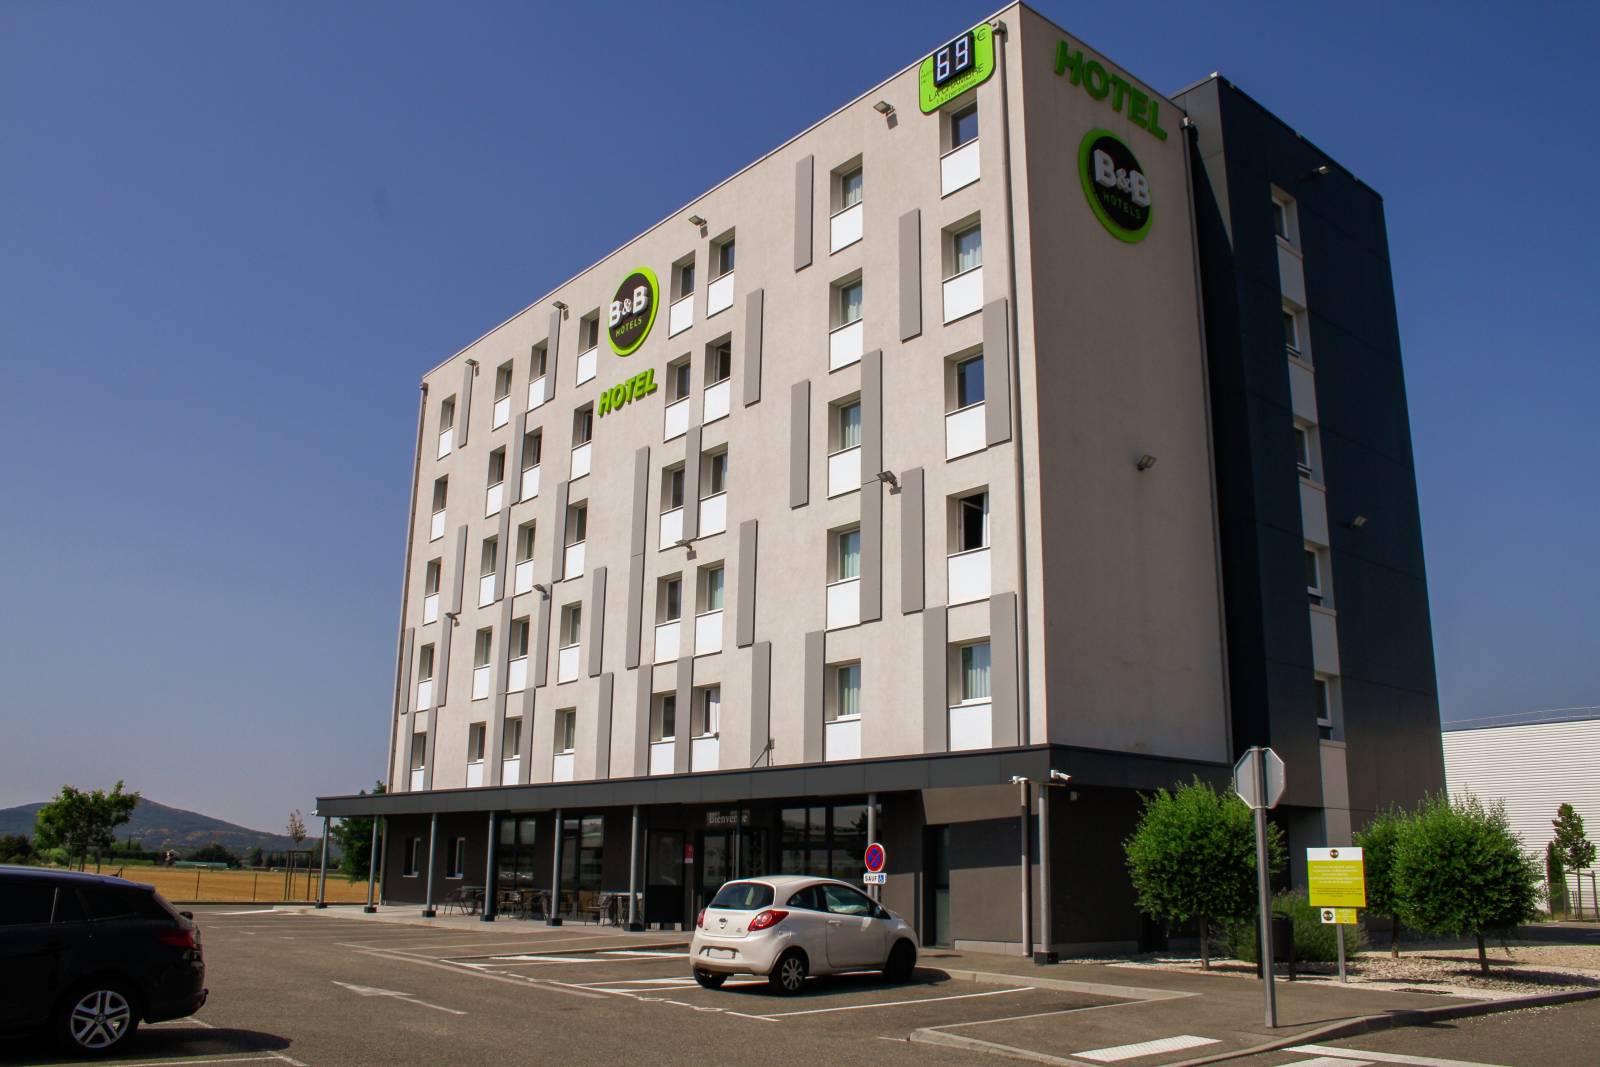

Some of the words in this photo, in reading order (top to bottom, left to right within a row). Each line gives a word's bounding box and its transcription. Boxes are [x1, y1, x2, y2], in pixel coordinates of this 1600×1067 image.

[936, 35, 968, 82] 69
[1055, 39, 1168, 140] HOTEL
[1093, 148, 1151, 208] B&B
[608, 285, 649, 328] B&B
[615, 317, 643, 338] HOTELS
[597, 367, 658, 418] HOTEL
